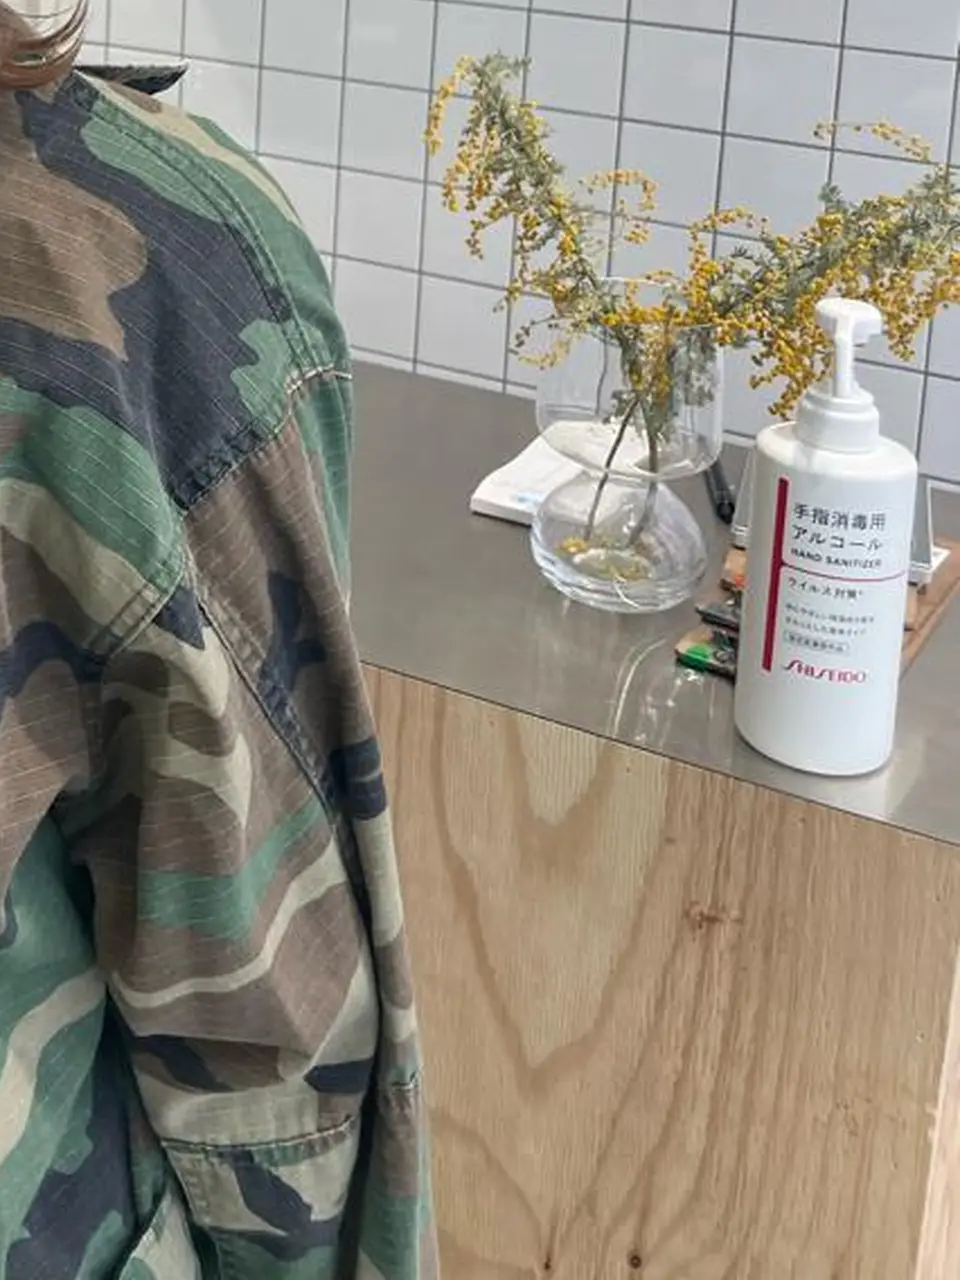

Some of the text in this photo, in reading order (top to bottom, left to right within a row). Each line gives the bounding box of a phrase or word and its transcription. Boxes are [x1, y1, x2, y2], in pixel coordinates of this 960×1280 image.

[794, 503, 886, 531] 手指消毒用
[792, 524, 883, 551] アルコール
[790, 547, 883, 569] HAND SANITIZER
[782, 659, 867, 683] SHISEIDO
